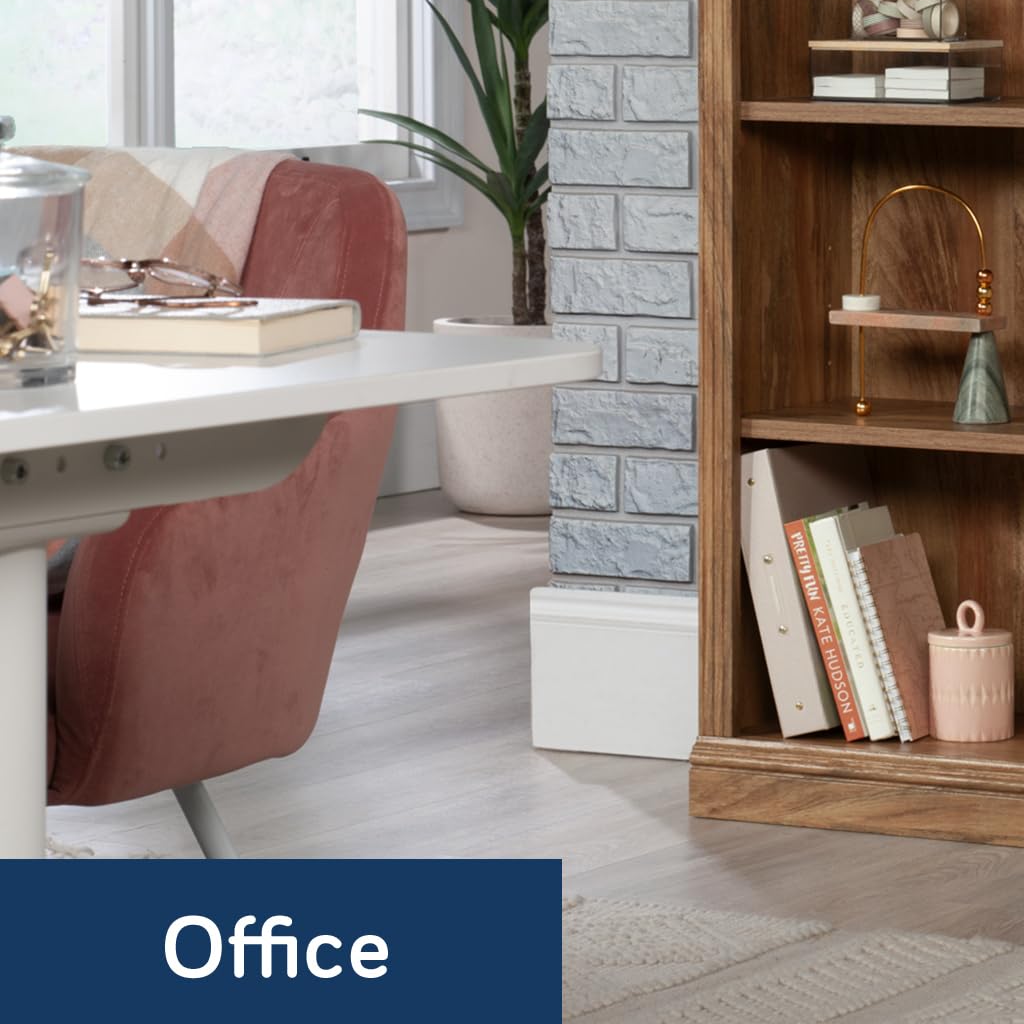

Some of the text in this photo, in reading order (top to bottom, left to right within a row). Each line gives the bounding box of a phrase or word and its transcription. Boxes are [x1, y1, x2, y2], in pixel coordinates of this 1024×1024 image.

[803, 575, 821, 601] FUN
[813, 606, 833, 645] KATE
[825, 648, 853, 714] HUDSON
